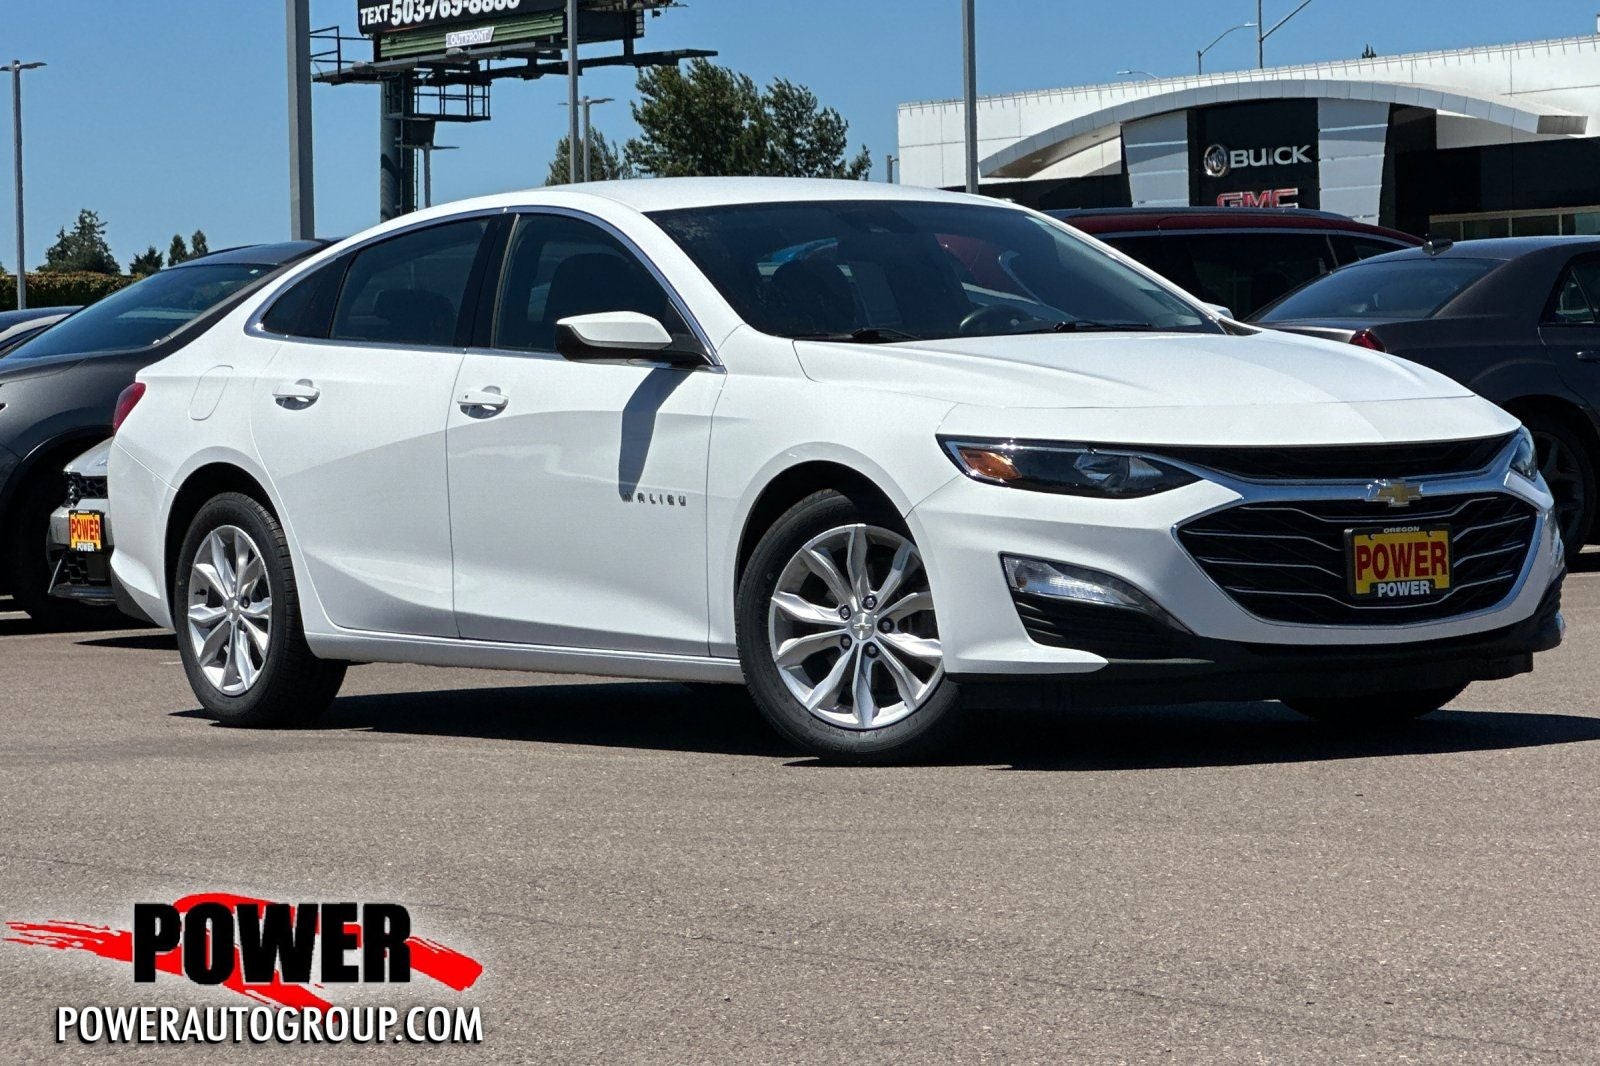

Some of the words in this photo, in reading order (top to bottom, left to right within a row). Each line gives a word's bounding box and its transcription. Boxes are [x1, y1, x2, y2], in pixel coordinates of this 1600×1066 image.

[360, 4, 390, 26] TEXT
[450, 30, 489, 45] OUTFRONT
[1230, 144, 1312, 169] BUICK
[1216, 187, 1298, 209] GMC
[71, 518, 100, 541] POWER
[1383, 525, 1420, 534] OREGON
[1356, 541, 1449, 581] POWER
[1377, 580, 1431, 598] POWER
